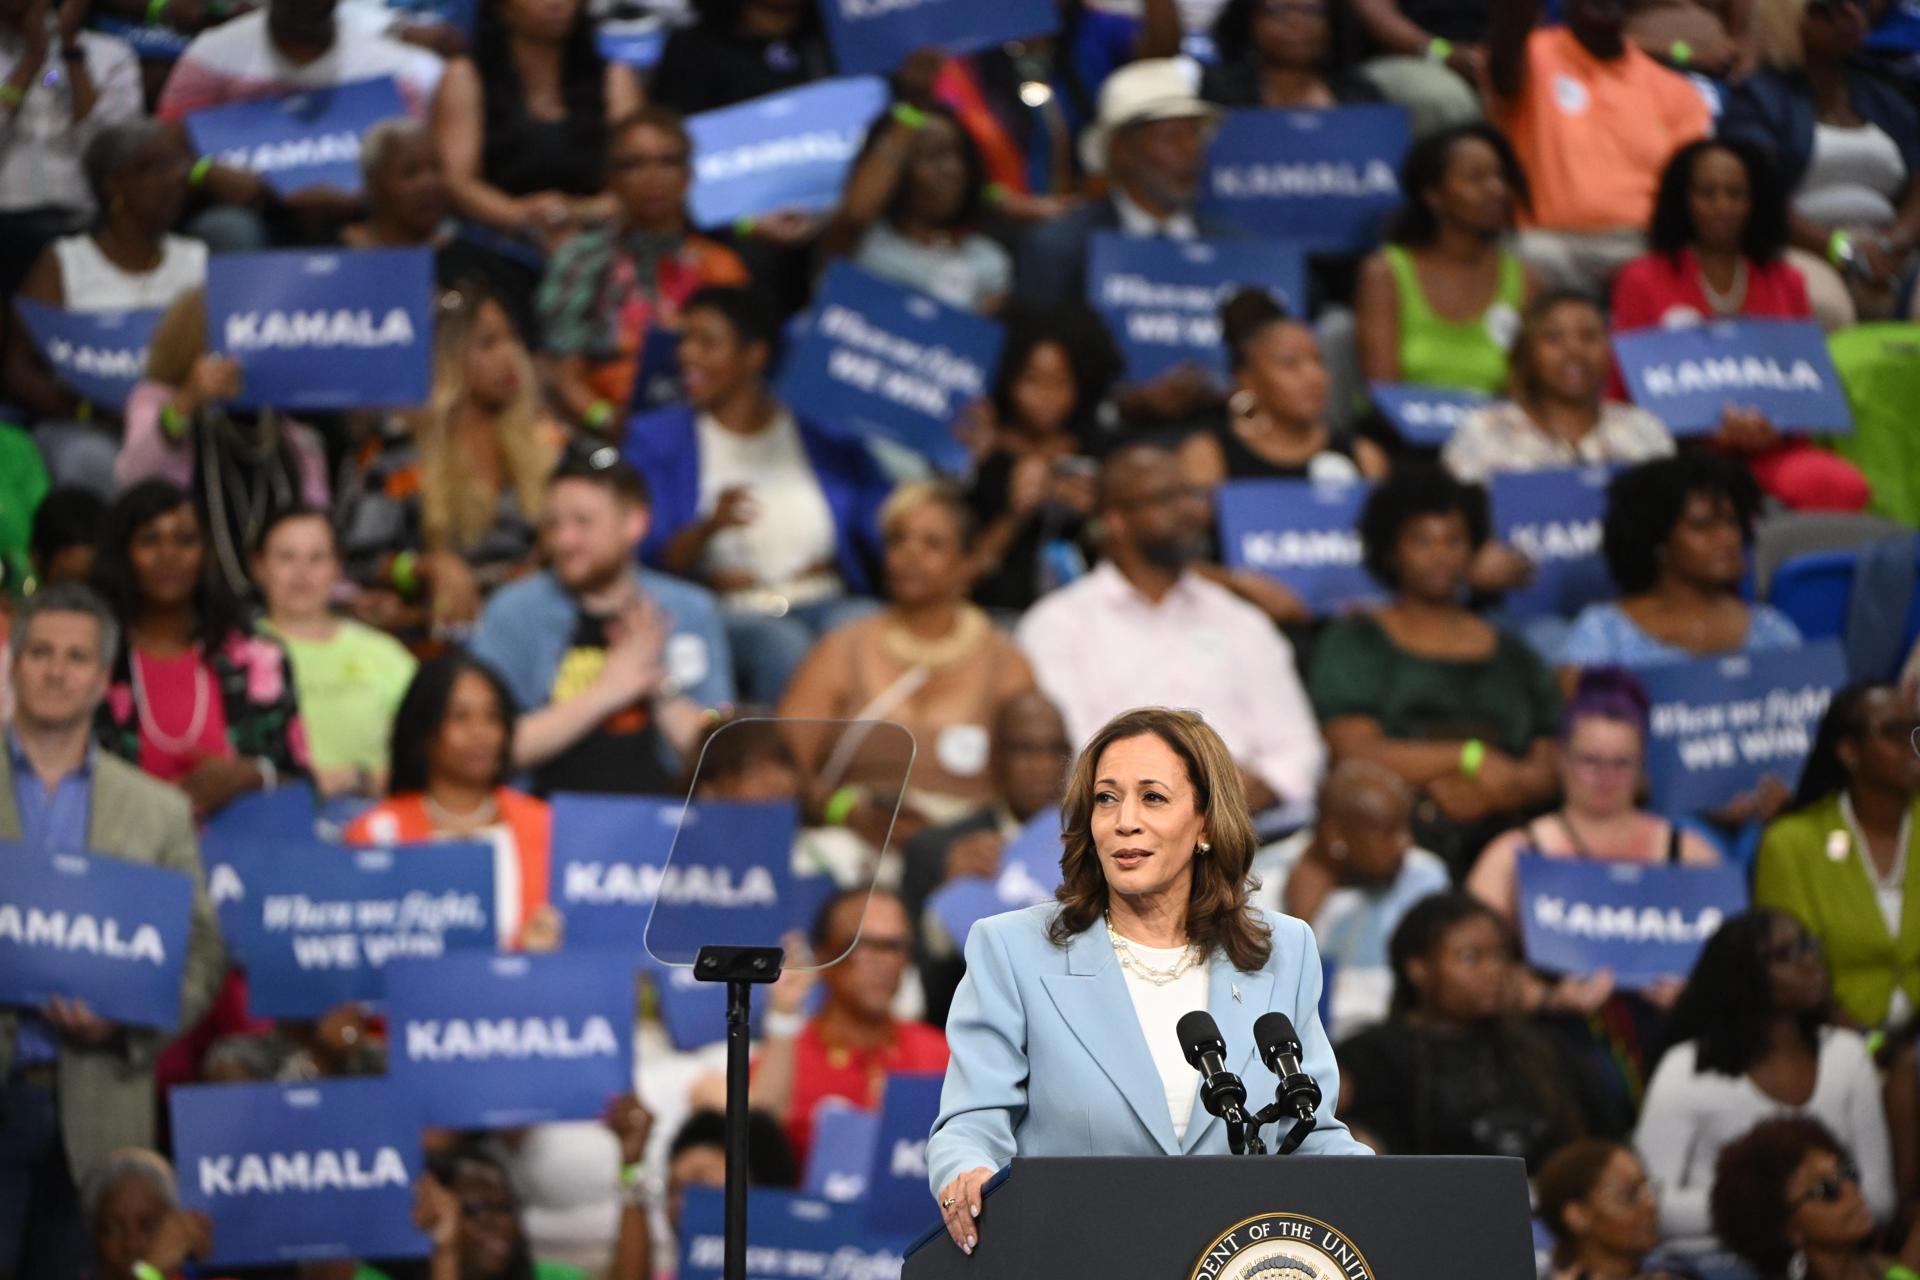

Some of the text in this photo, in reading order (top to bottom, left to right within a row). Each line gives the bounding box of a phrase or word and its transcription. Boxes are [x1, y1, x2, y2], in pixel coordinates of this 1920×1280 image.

[226, 309, 413, 350] KAMALA
[1643, 357, 1822, 398] KAMALA
[1652, 701, 1725, 737] When
[1679, 733, 1737, 770] WE
[563, 861, 778, 907] KAMALA
[262, 894, 353, 932] When
[356, 900, 396, 927] we
[0, 903, 166, 966] AMALA
[293, 933, 360, 970] WE
[406, 1016, 619, 1062] KAMALA
[198, 1147, 409, 1196] KAMALA
[1249, 1223, 1271, 1240] OF
[1279, 1222, 1313, 1240] THE
[1322, 1231, 1368, 1280] UNIT
